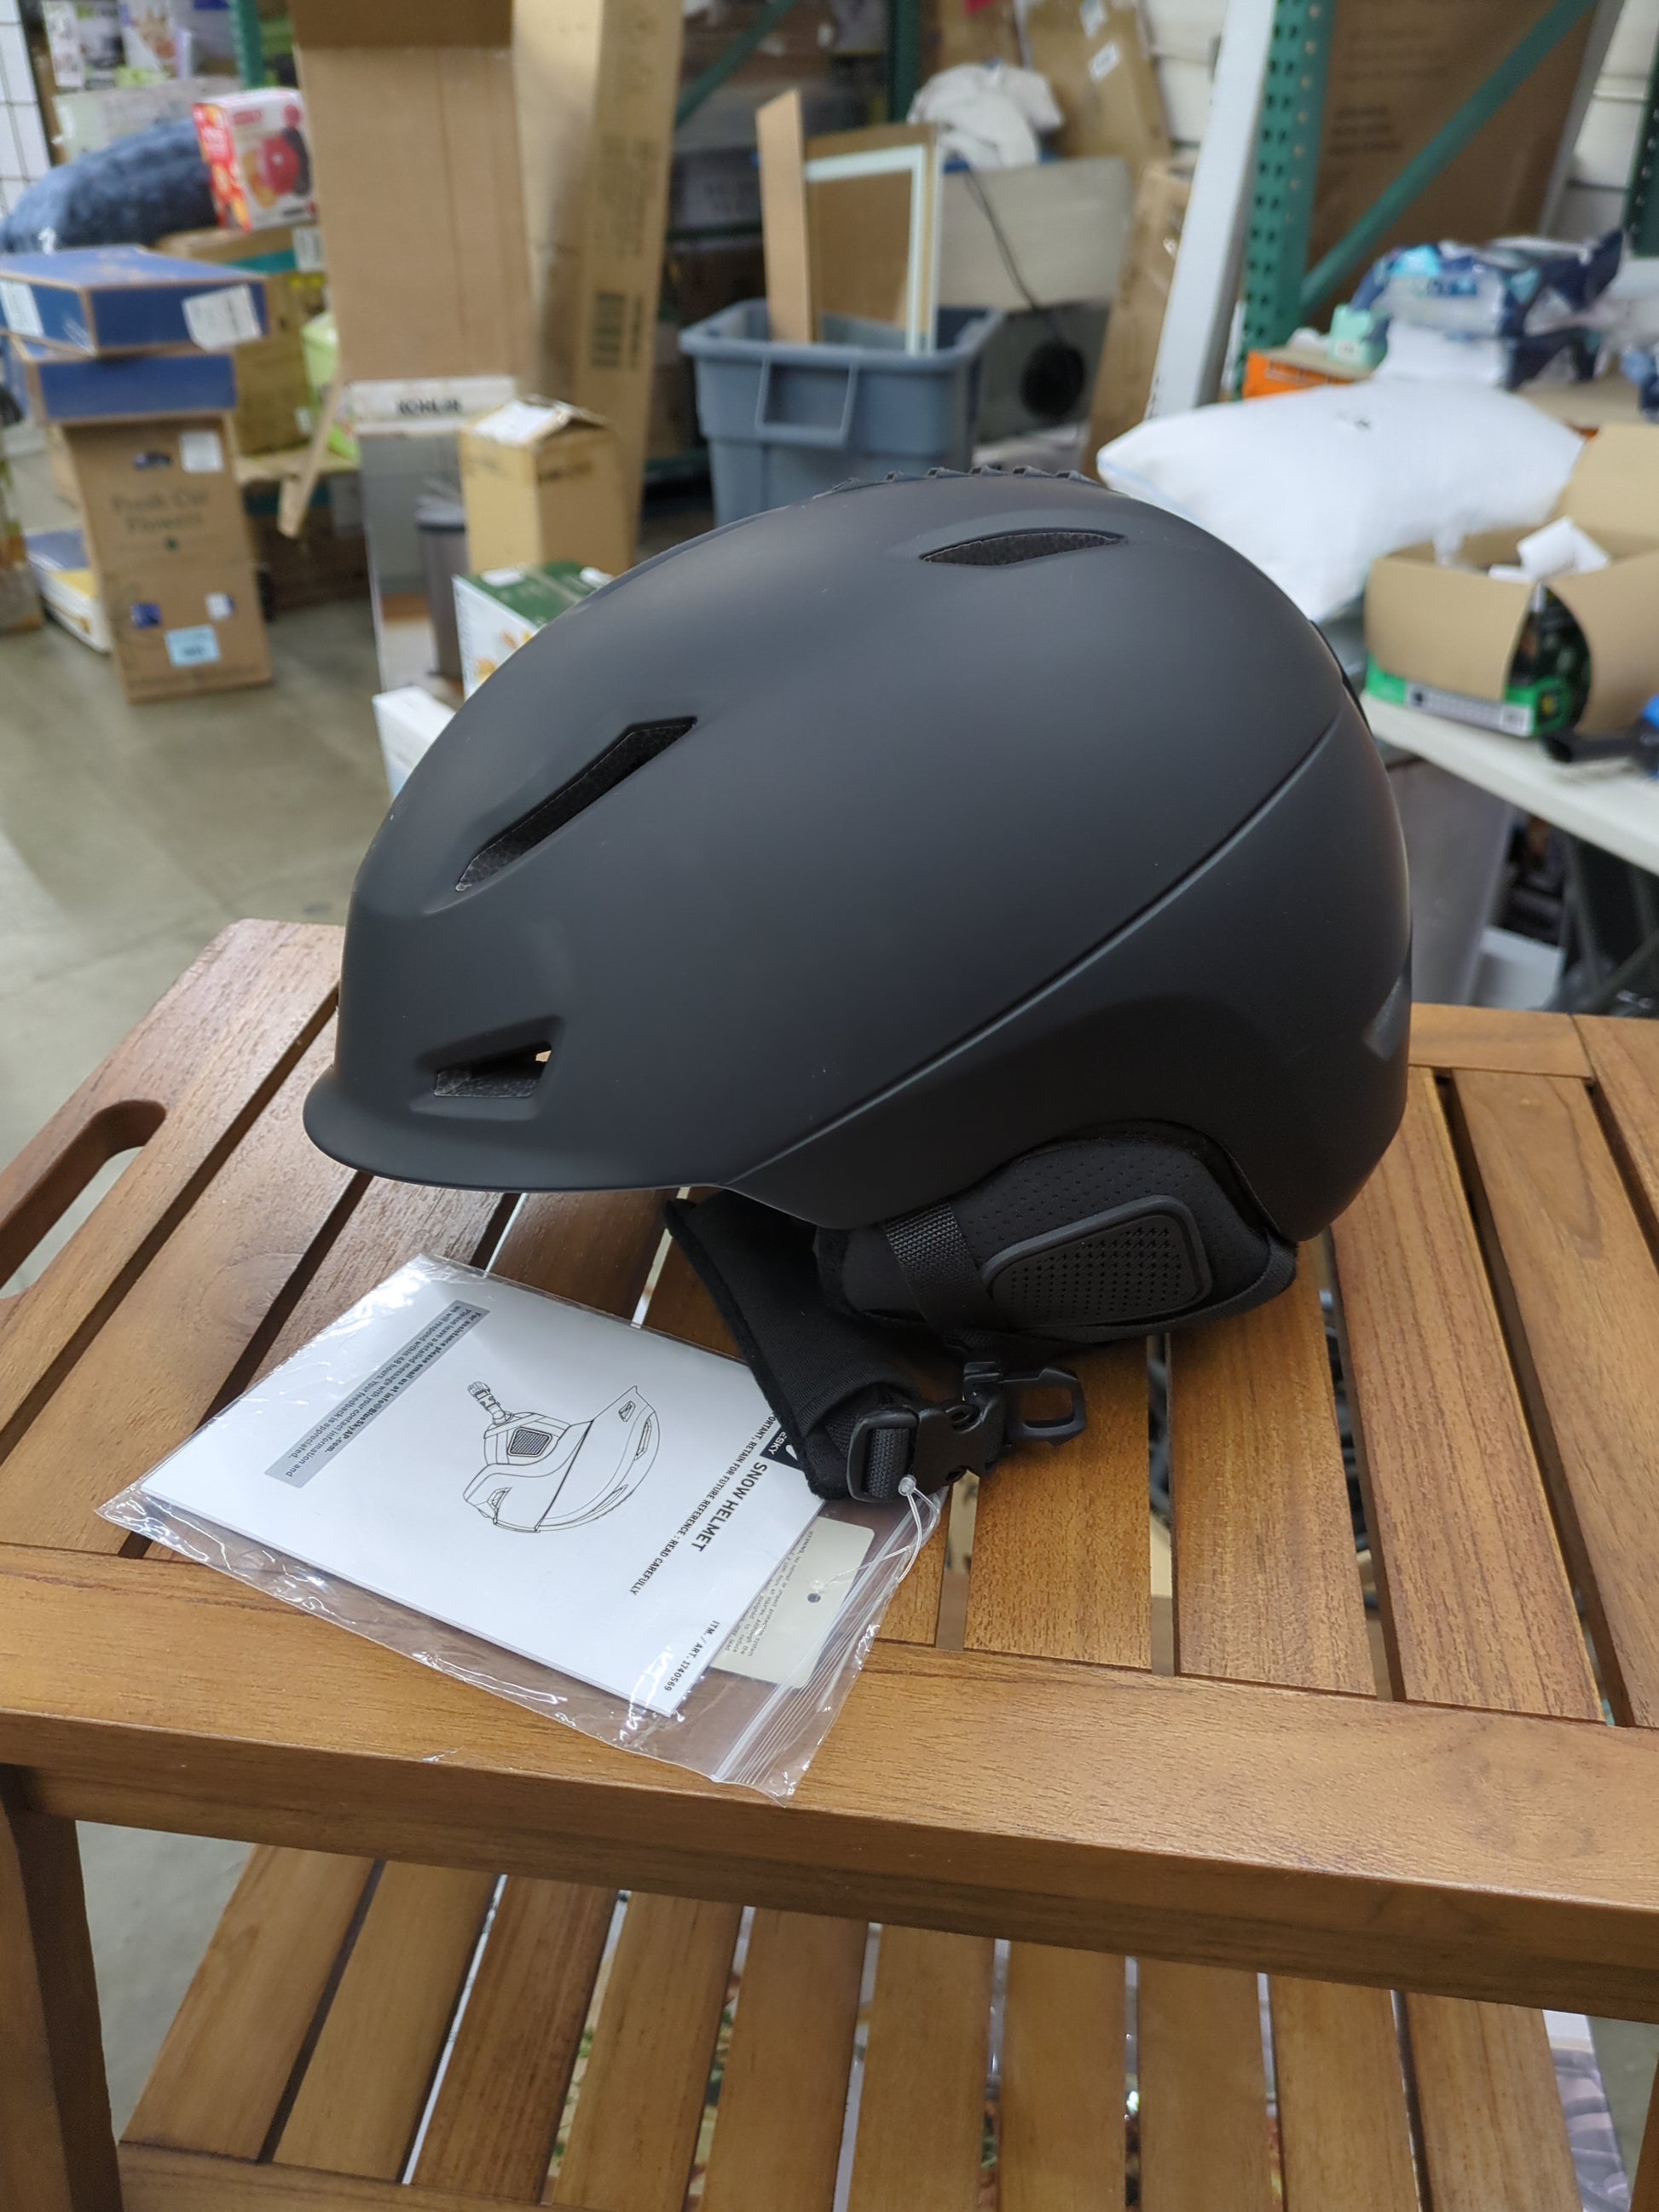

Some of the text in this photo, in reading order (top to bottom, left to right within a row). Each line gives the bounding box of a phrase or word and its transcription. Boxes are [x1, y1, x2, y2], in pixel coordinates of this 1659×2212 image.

[439, 1312, 454, 1322] will
[449, 1308, 472, 1325] Please
[467, 1311, 482, 1321] For
[417, 1320, 444, 1342] respond
[434, 1324, 454, 1339] leave
[438, 1320, 472, 1348] assistance
[401, 1339, 423, 1357] within
[407, 1341, 435, 1364] detailed
[419, 1345, 443, 1364] please
[392, 1355, 406, 1365] 48
[381, 1361, 411, 1386] message
[404, 1363, 425, 1379] email
[361, 1379, 379, 1393] Your
[369, 1384, 387, 1398] with
[389, 1384, 401, 1393] at
[332, 1390, 367, 1418] feedback
[356, 1395, 373, 1409] your
[333, 1408, 361, 1431] contact
[750, 1415, 777, 1442] ORTANT,
[286, 1422, 332, 1460] appreciated.
[297, 1429, 339, 1465] information
[765, 1430, 789, 1455] ESKY
[734, 1441, 757, 1463] RETAIN
[284, 1463, 303, 1477] and
[724, 1462, 740, 1476] FOR
[705, 1475, 730, 1499] FUTURE
[688, 1461, 769, 1551] SNOW HELMET
[675, 1499, 711, 1536] REFERENCE
[658, 1539, 679, 1557] READ
[627, 1556, 664, 1596] CAREFULLY
[702, 1618, 720, 1638] ITM.
[685, 1641, 703, 1662] ART.
[662, 1658, 691, 1694] 1740569
